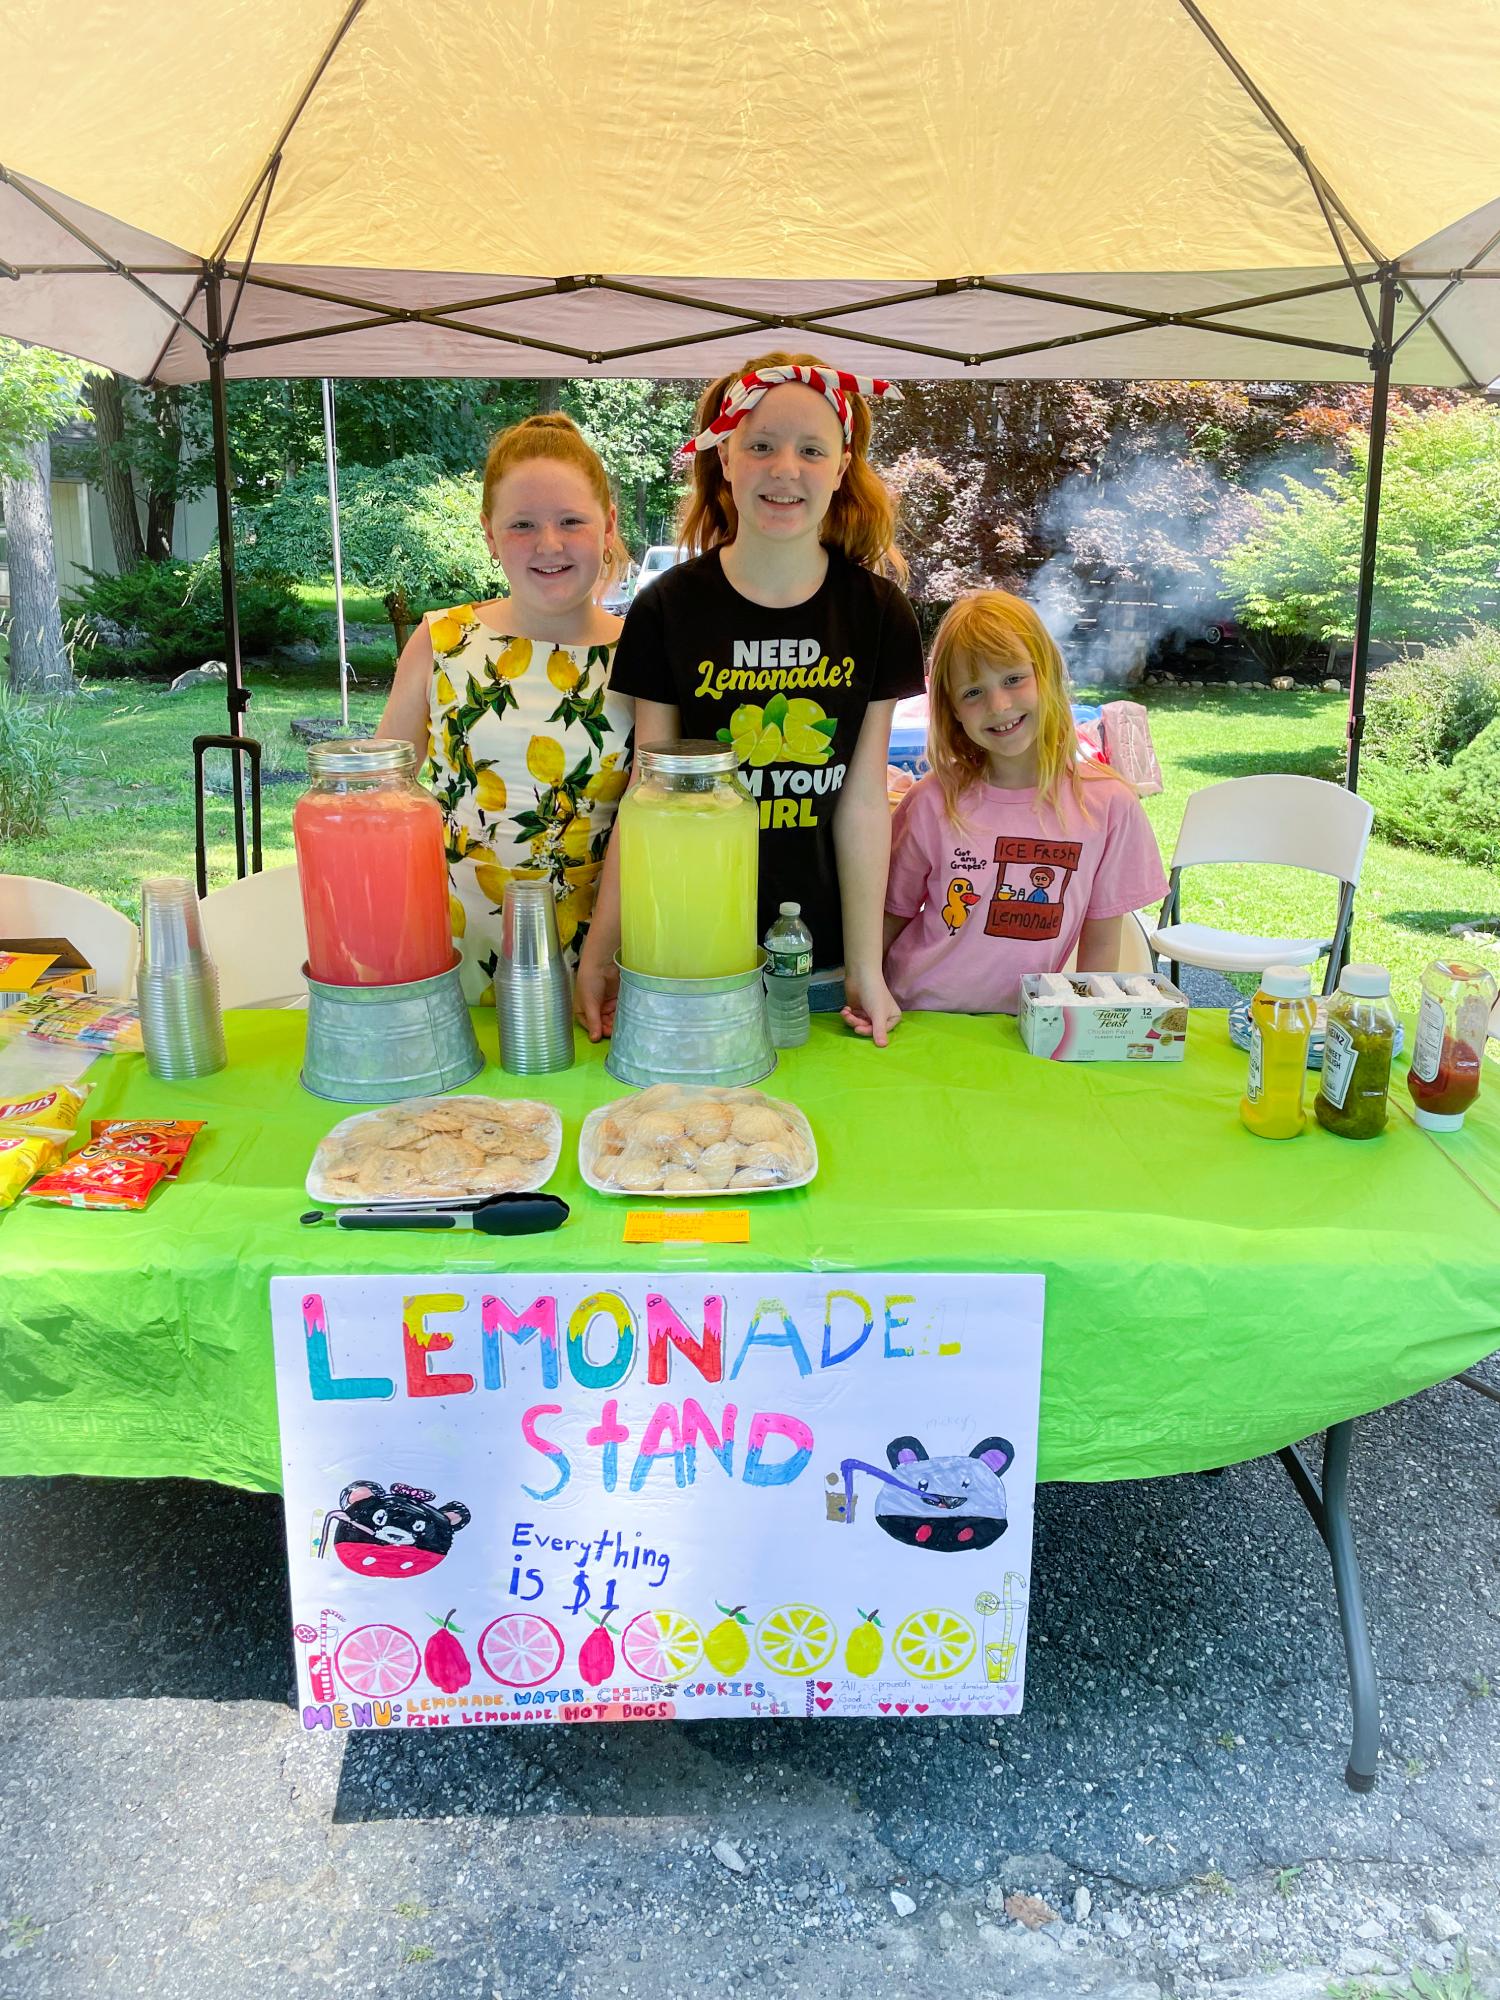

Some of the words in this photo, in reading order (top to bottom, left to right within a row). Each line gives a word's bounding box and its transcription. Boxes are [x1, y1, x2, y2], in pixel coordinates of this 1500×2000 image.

[733, 639, 821, 667] NEED
[694, 656, 855, 700] Lemonade?
[736, 769, 763, 797] M
[770, 764, 847, 796] YOUR
[759, 798, 818, 830] IRL
[954, 848, 972, 856] Got
[1000, 843, 1026, 858] ICE
[950, 860, 987, 872] Grapes?
[1094, 1009, 1130, 1021] Fancy
[1097, 1018, 1128, 1029] Feast
[1142, 1007, 1152, 1015] 12
[302, 1289, 918, 1402] LEMONADE
[511, 1523, 671, 1588] Everything
[509, 1554, 545, 1602] is
[562, 1570, 620, 1616] $1
[302, 1700, 403, 1731] MENU:
[407, 1712, 450, 1727] PINK
[564, 1704, 609, 1721] HOT
[622, 1702, 668, 1718] DOGS
